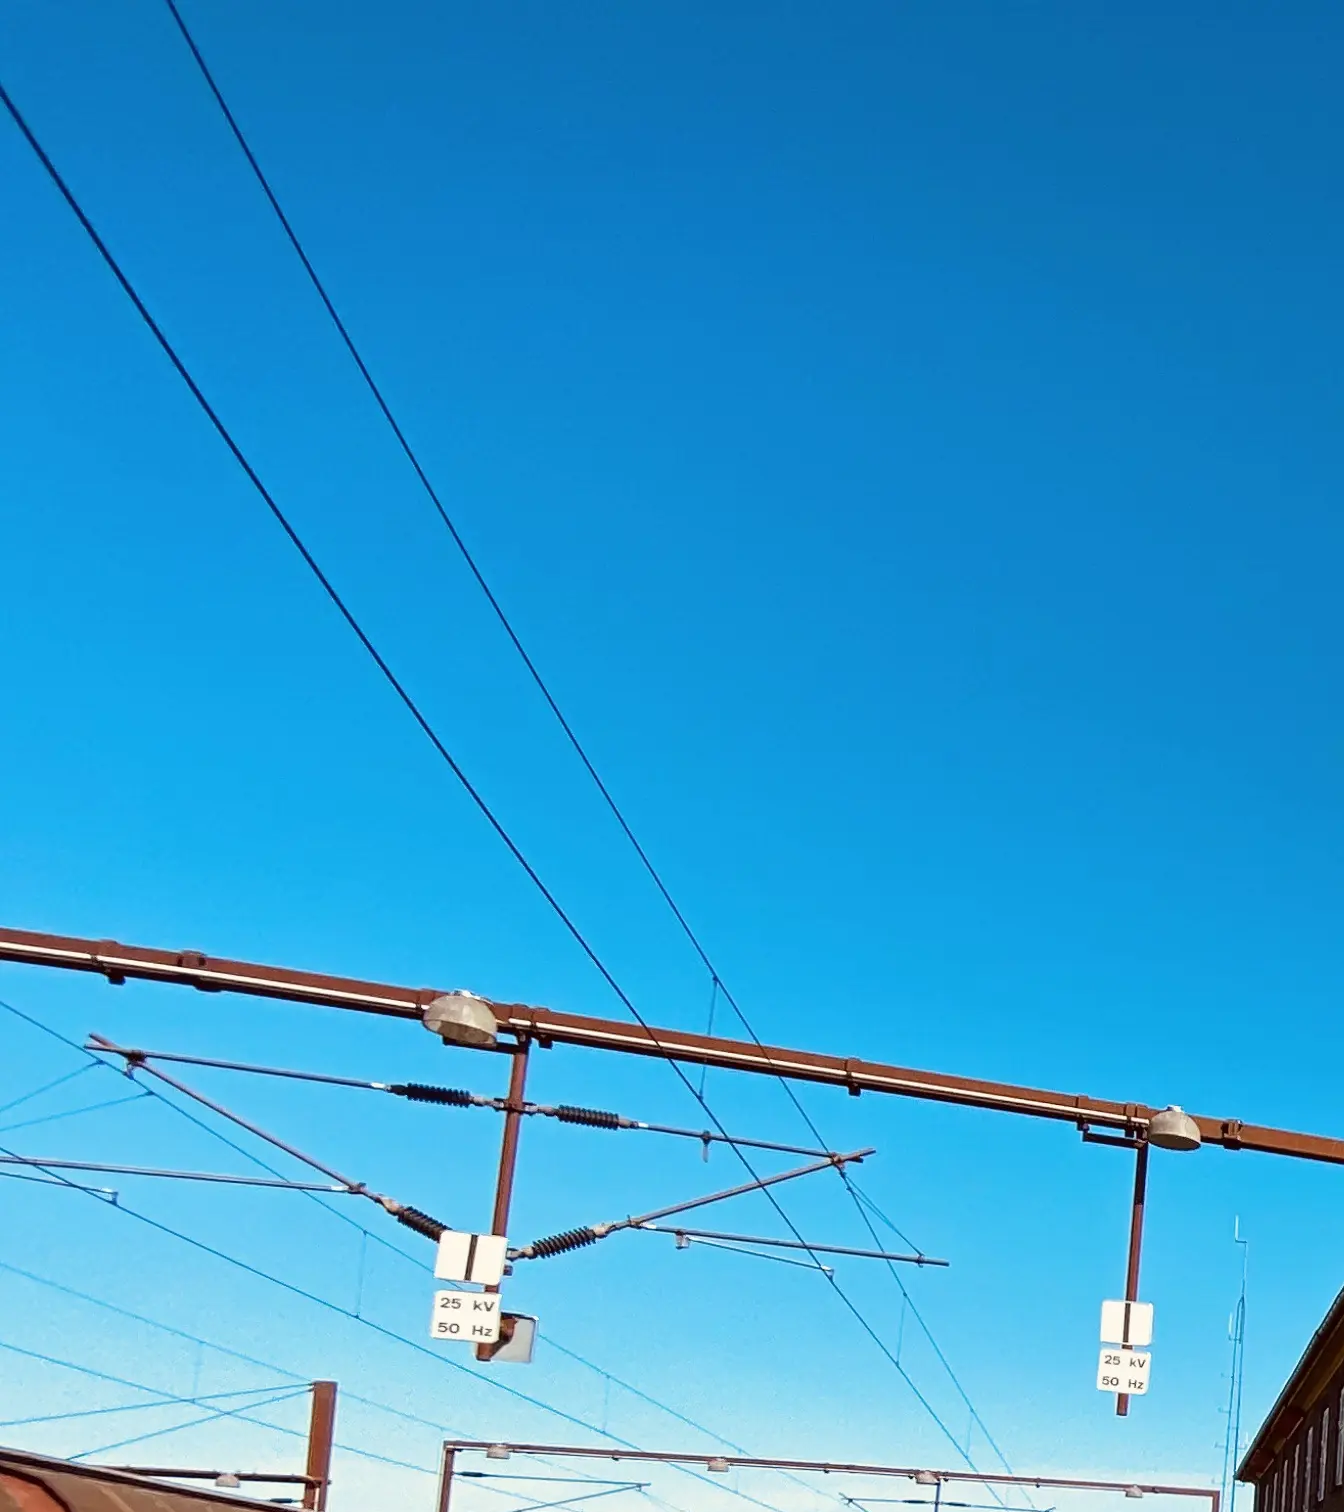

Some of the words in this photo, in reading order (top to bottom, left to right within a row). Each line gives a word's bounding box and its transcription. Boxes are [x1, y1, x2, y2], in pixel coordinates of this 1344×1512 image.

[440, 1297, 462, 1310] 25
[473, 1300, 495, 1312] kV
[438, 1322, 460, 1334] 50
[471, 1325, 493, 1337] Hz
[1104, 1355, 1121, 1365] 25
[1129, 1358, 1146, 1368] kV
[1102, 1376, 1119, 1386] 50
[1128, 1379, 1144, 1389] Hz
